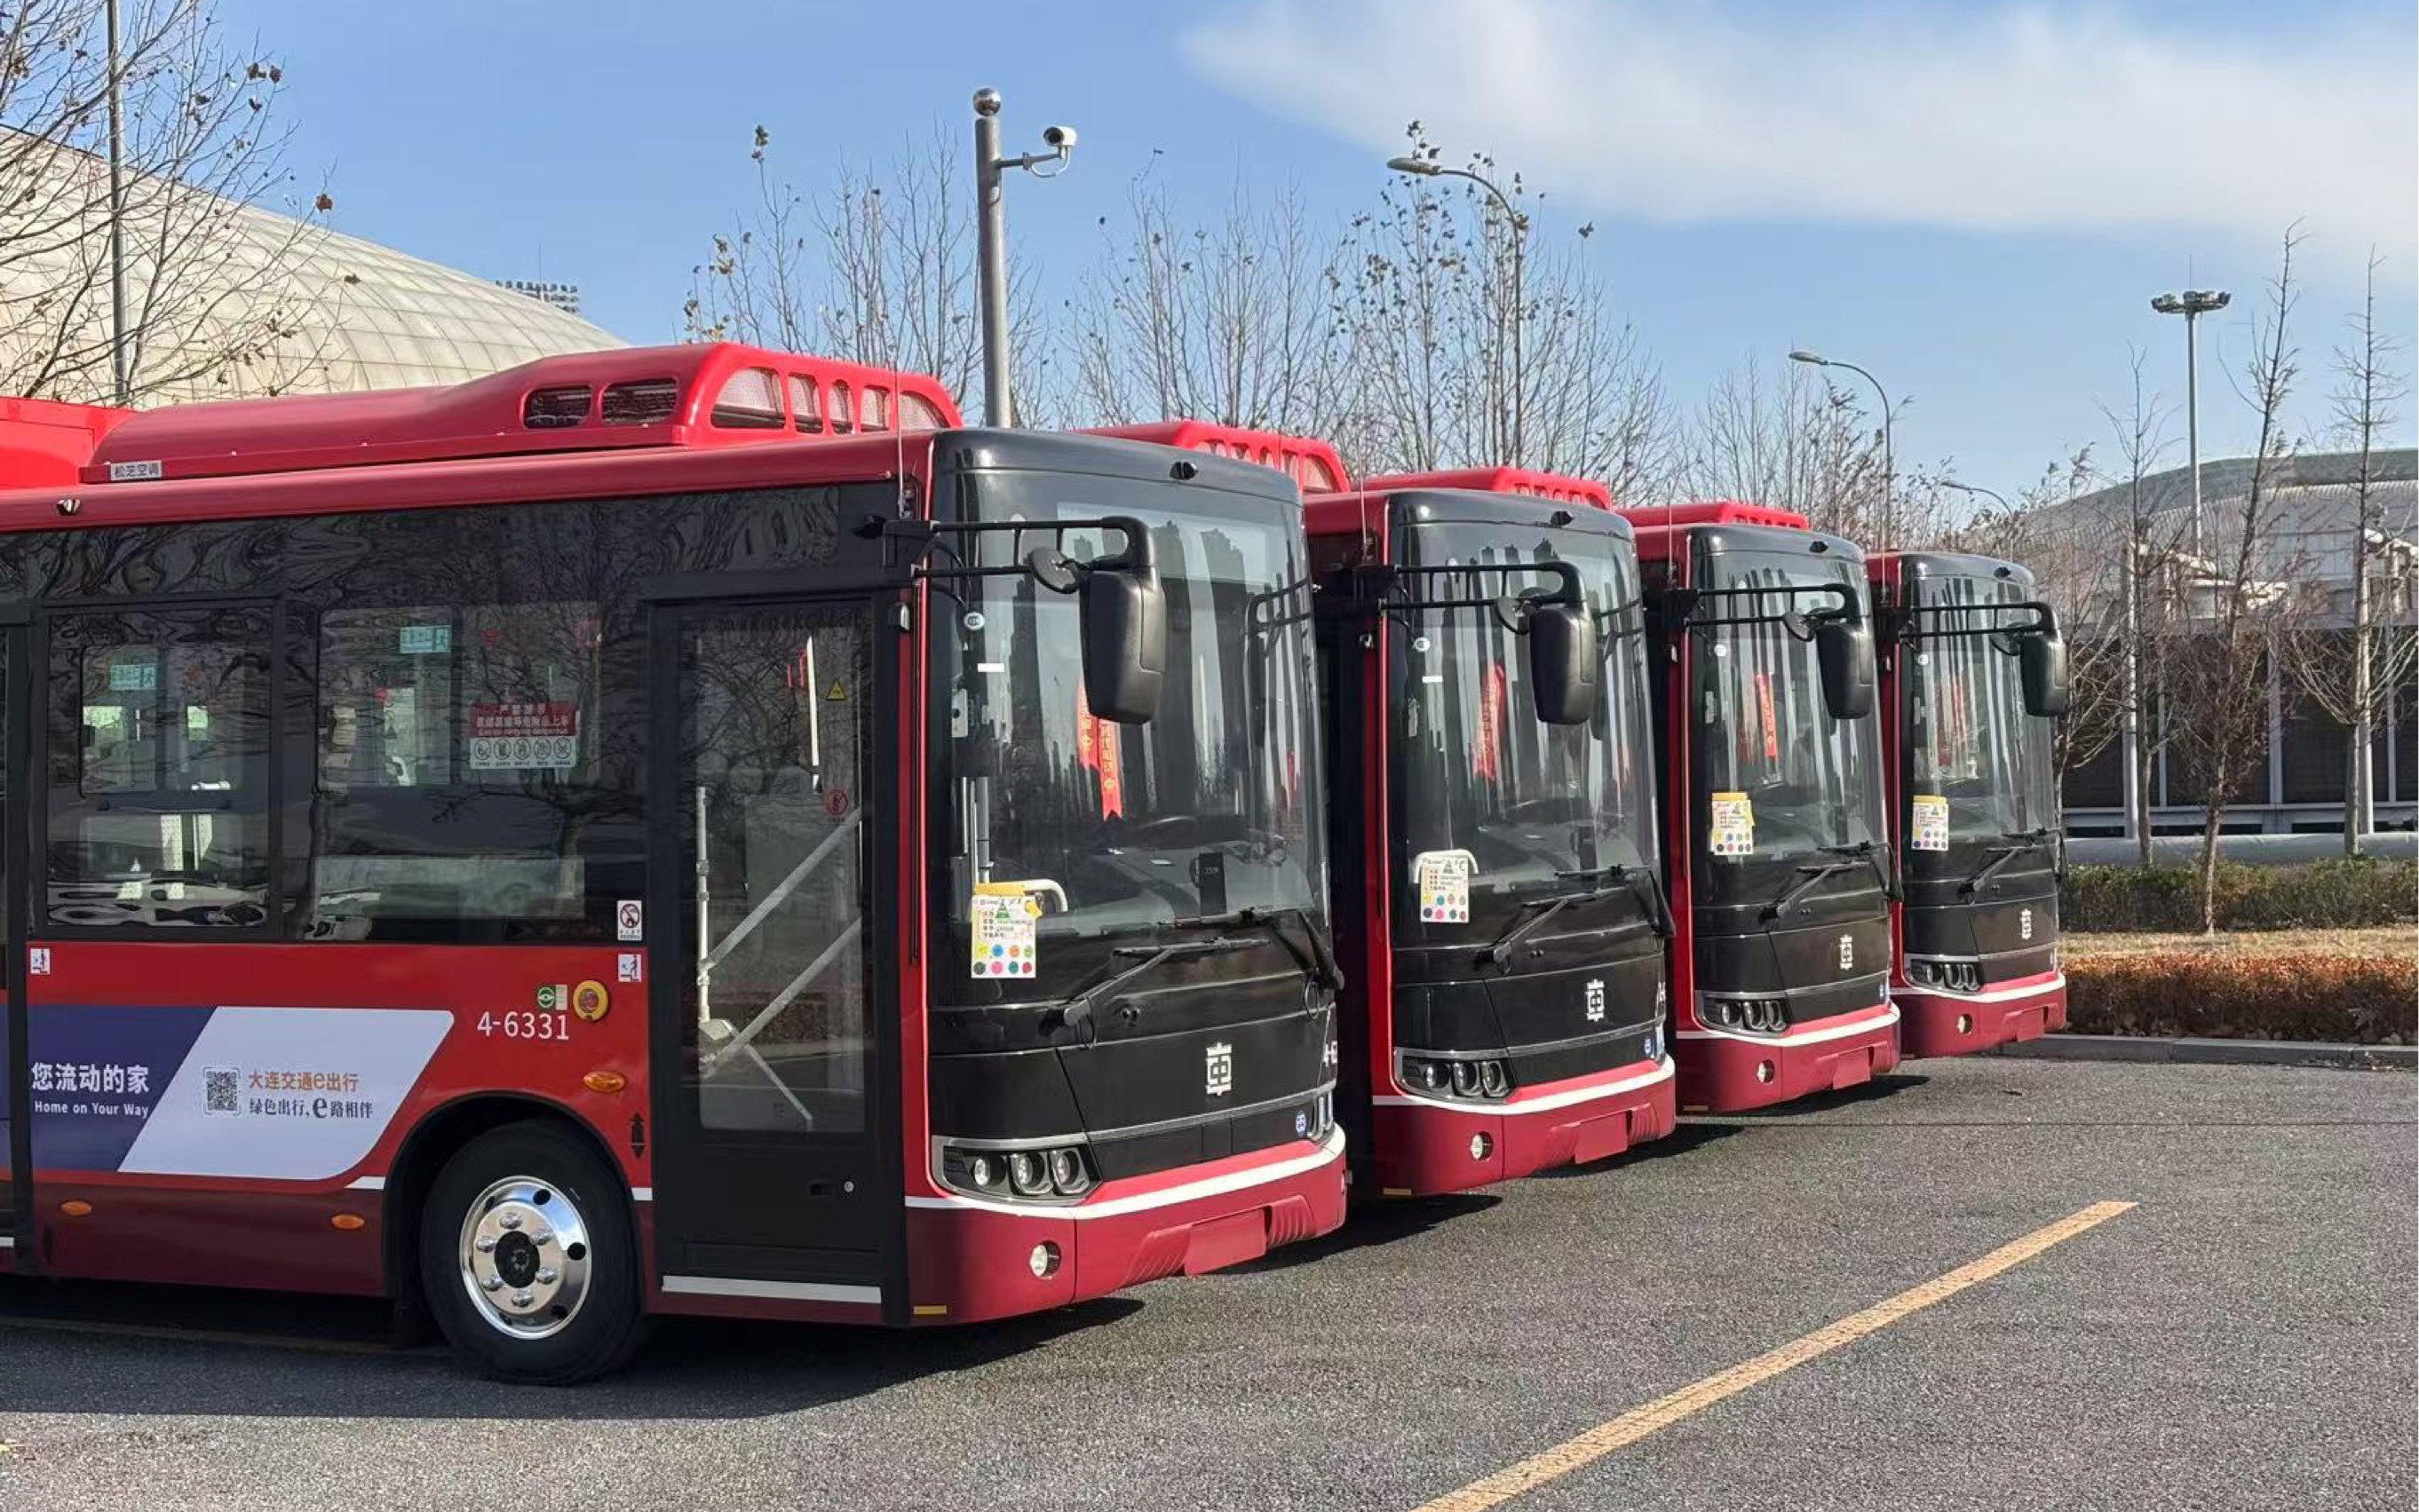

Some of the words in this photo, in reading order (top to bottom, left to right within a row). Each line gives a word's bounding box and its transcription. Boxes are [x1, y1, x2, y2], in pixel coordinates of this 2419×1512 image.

[477, 1010, 569, 1041] 4-6331
[30, 1062, 150, 1094] 您流动的家
[249, 1069, 360, 1092] 大连交通e出行
[35, 1100, 69, 1113] Home
[73, 1104, 88, 1114] on
[91, 1102, 119, 1115] Your
[123, 1103, 149, 1119] Way
